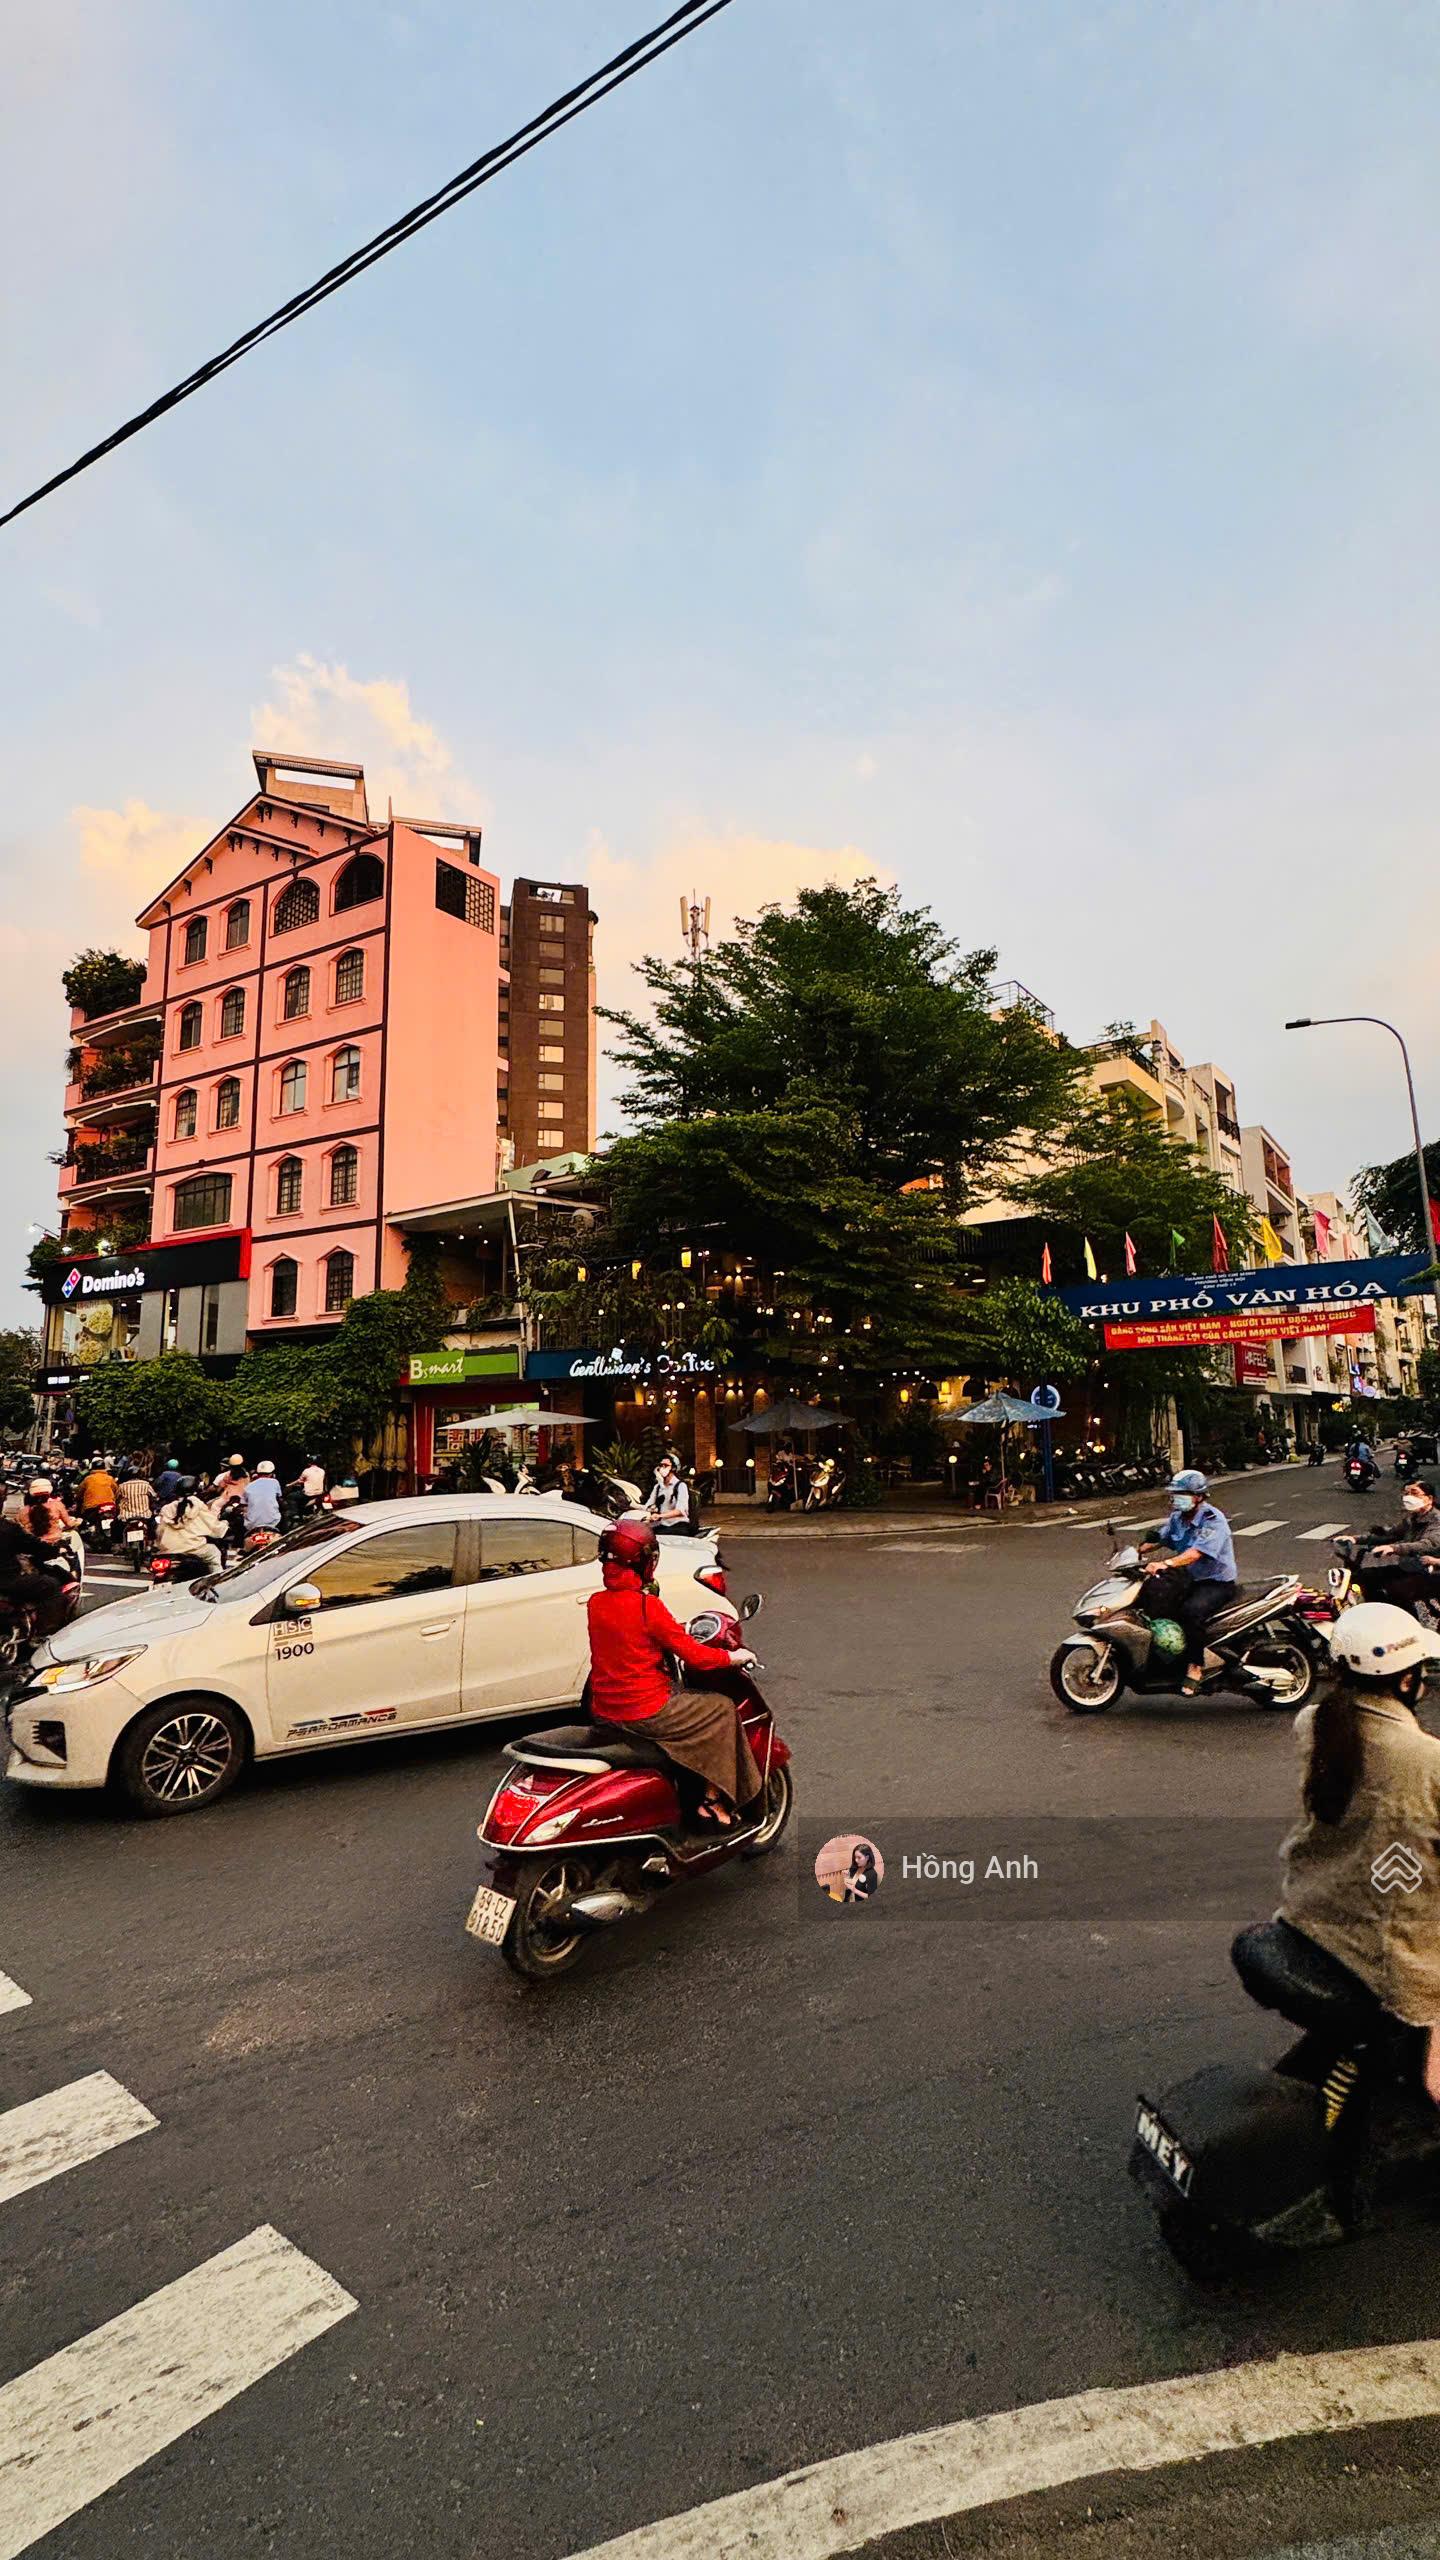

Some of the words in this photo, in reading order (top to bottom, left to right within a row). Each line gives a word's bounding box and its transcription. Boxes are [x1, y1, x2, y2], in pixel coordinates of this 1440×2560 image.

[82, 1266, 145, 1294] Domino's
[1080, 1302, 1140, 1318] KHU
[1150, 1290, 1214, 1313] PHỐ
[1226, 1287, 1297, 1306] VĂN
[1305, 1280, 1388, 1301] HÓA
[1199, 1321, 1221, 1330] NAM
[274, 1617, 313, 1636] HSC
[275, 1642, 314, 1660] 1900
[287, 1711, 397, 1738] PERFORMANCE
